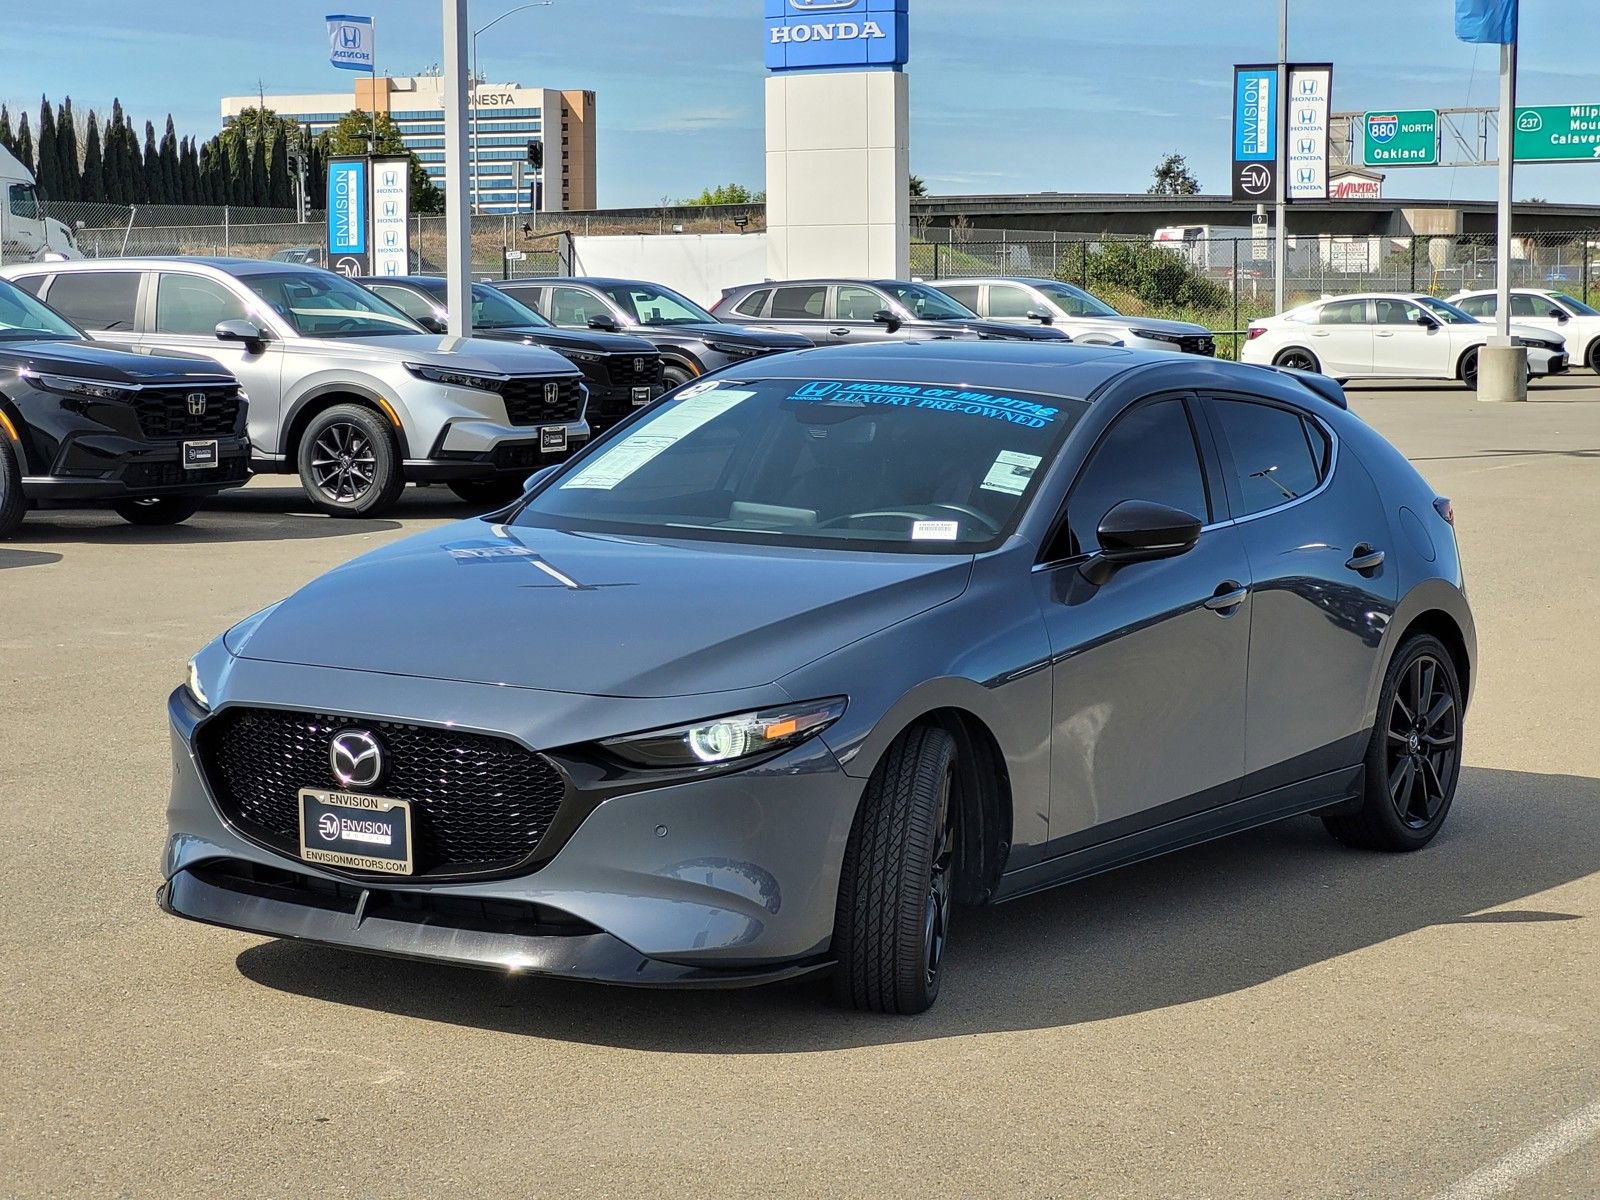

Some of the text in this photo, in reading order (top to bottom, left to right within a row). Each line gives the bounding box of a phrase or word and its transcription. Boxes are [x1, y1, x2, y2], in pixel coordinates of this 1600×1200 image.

[770, 21, 886, 44] HONDA
[467, 93, 515, 106] NESTA
[1243, 78, 1258, 154] ENVISION
[1259, 85, 1267, 147] MOTORS
[1520, 118, 1539, 128] 237
[1371, 123, 1434, 137] 880 NORTH
[1373, 147, 1426, 159] Oakland
[336, 170, 349, 247] ENVISION
[830, 391, 1046, 428] LUXURY PRE-OWNED
[844, 383, 1059, 416] HONDA OF MILPITAS
[329, 793, 378, 809] ENVISION
[341, 818, 392, 835] ENVISION
[306, 850, 407, 873] ENVISIONMOTORS.COM
